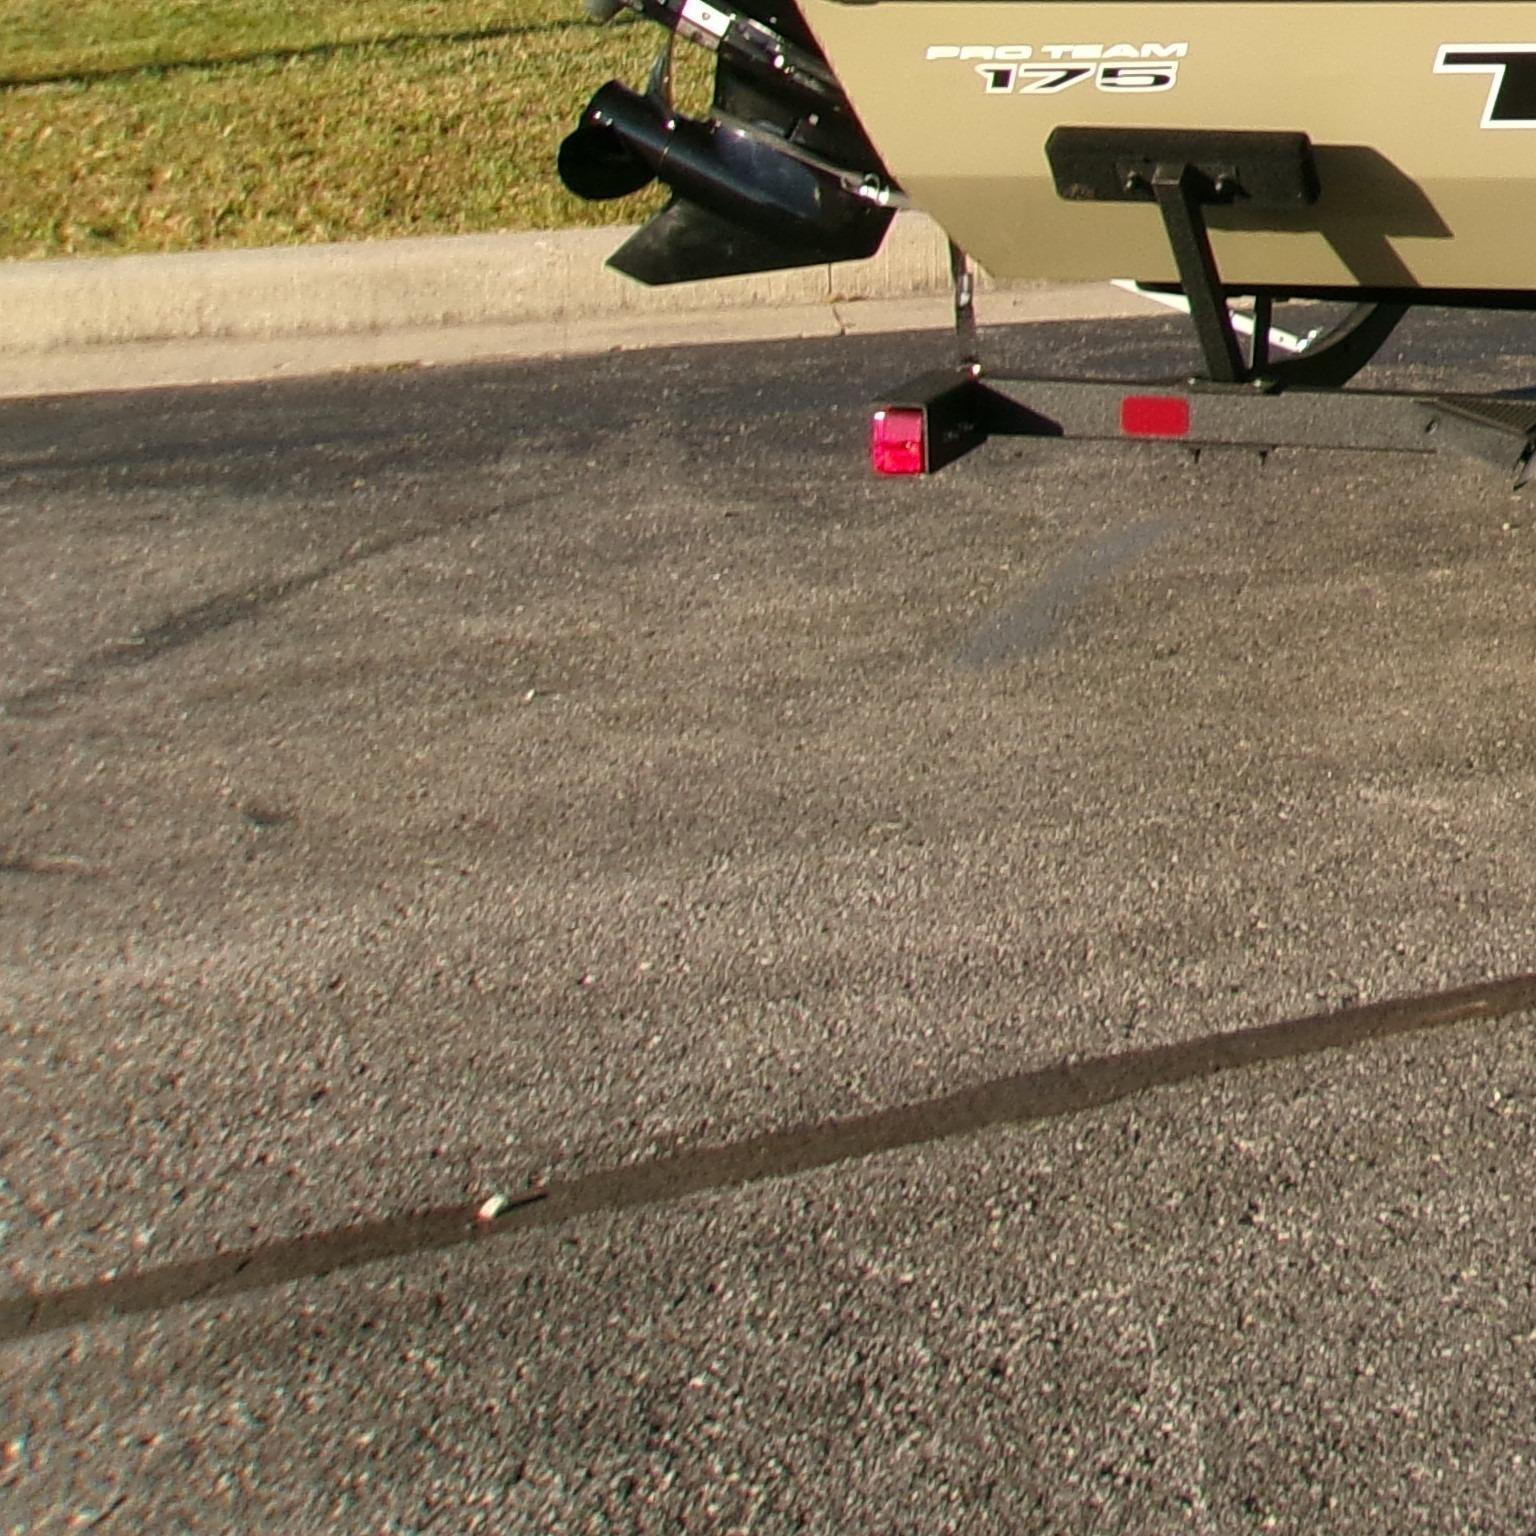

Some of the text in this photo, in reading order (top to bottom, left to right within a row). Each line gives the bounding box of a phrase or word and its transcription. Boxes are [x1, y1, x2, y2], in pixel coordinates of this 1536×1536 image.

[925, 42, 1189, 61] PRO TEAM
[974, 60, 1179, 94] 175
